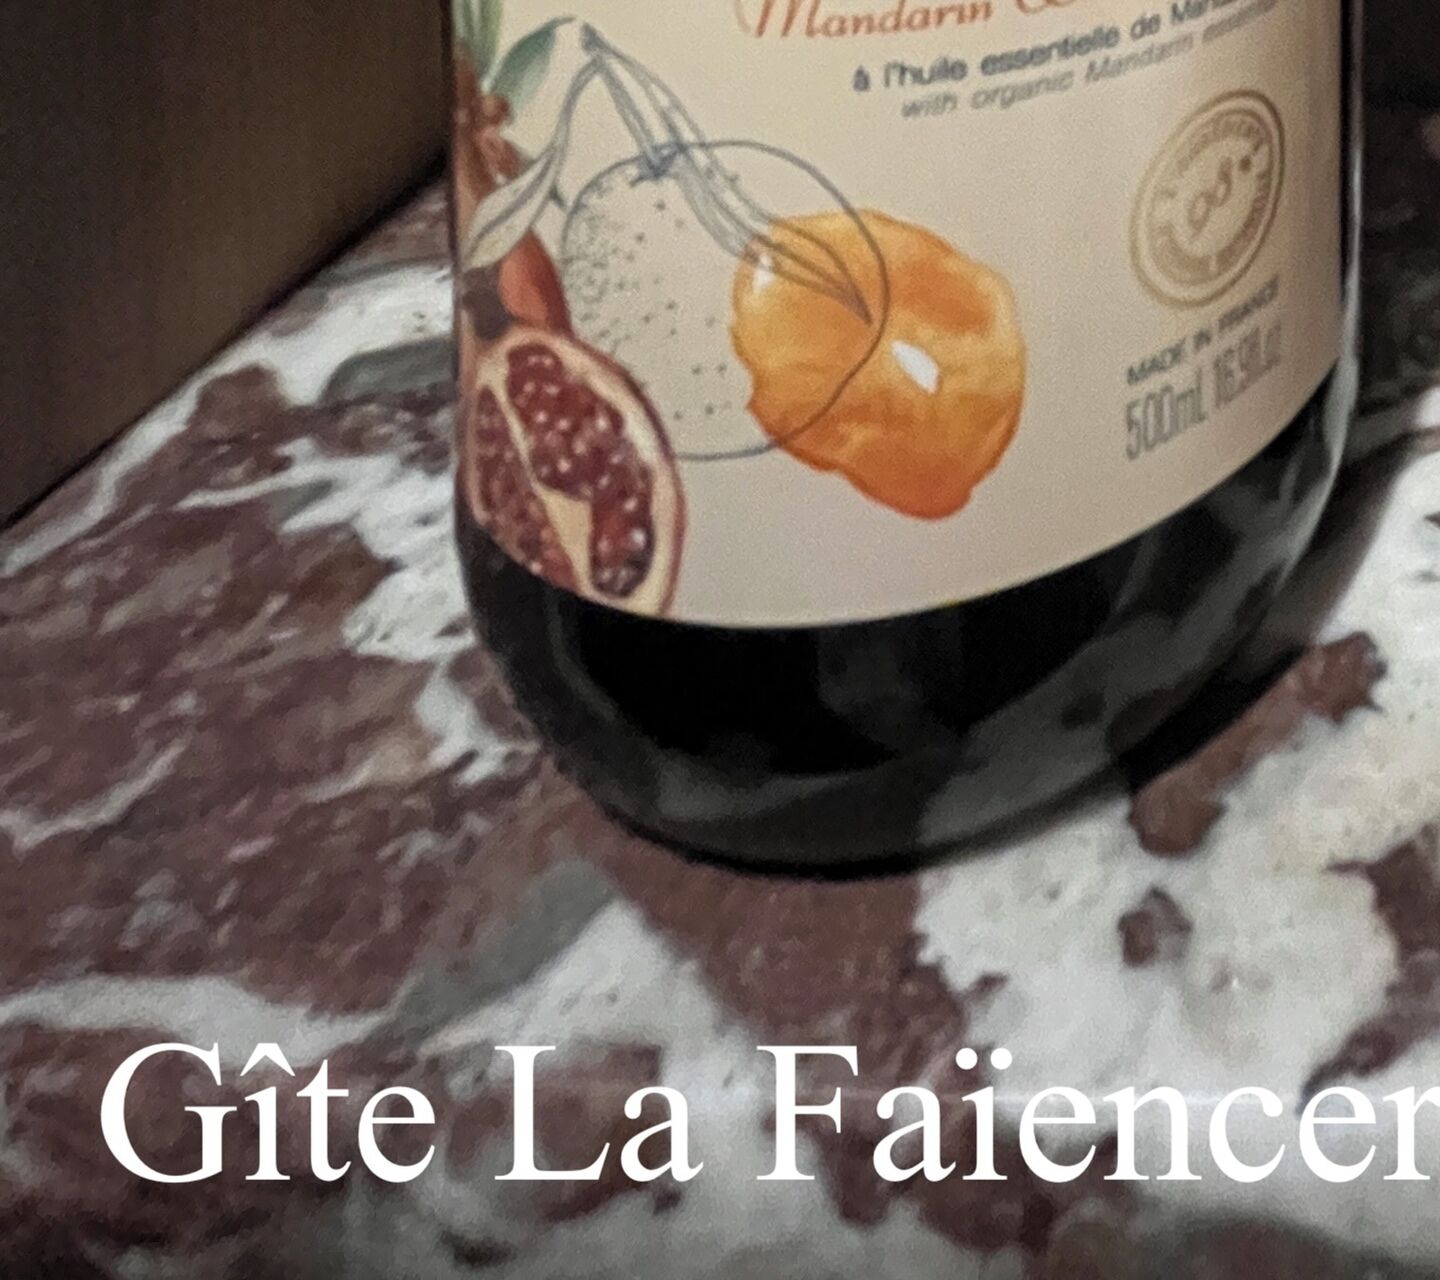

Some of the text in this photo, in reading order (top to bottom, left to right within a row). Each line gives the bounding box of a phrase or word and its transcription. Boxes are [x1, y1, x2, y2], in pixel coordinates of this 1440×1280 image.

[980, 24, 1121, 76] essentielle
[1130, 12, 1161, 42] de
[901, 90, 958, 119] with
[970, 68, 1075, 110] organic
